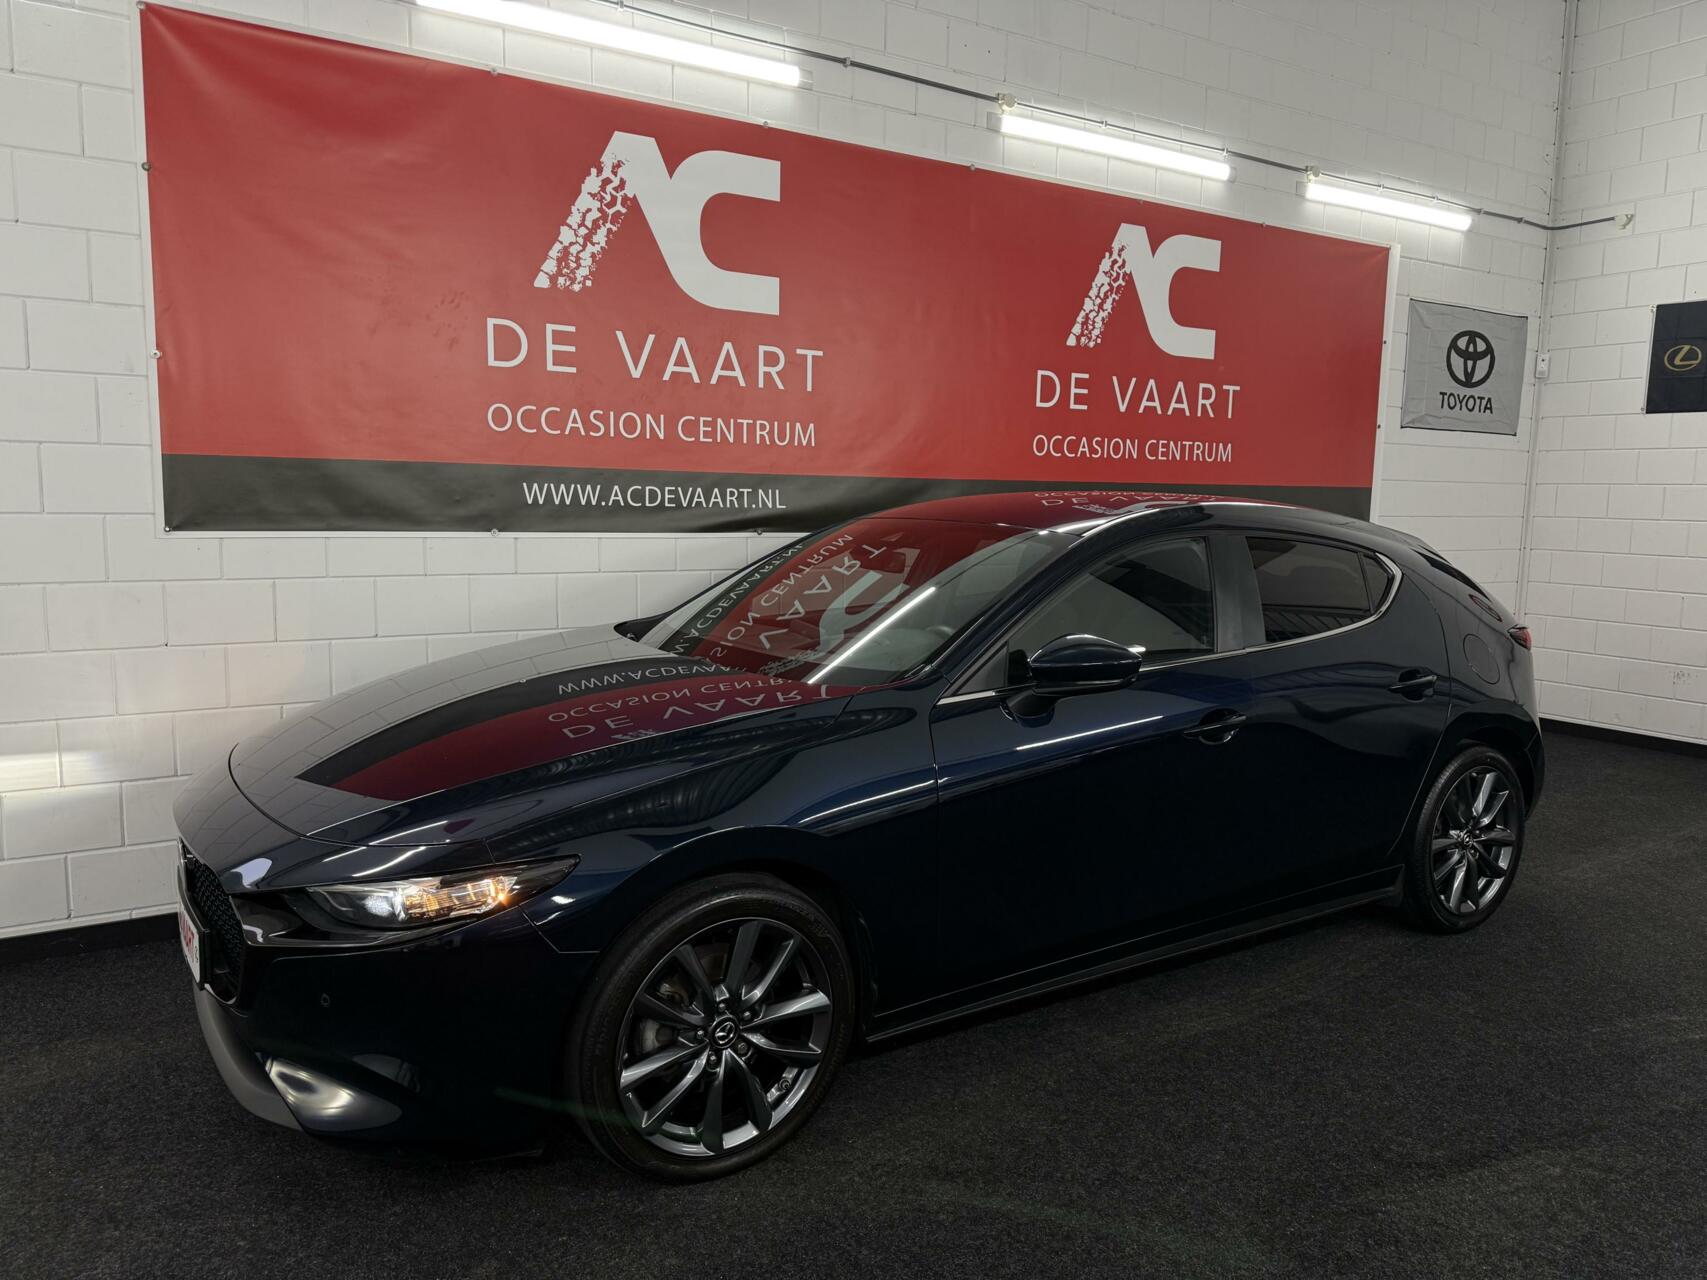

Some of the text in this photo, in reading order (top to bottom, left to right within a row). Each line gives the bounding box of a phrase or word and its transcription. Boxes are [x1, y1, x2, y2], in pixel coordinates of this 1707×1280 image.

[533, 130, 781, 316] AC
[1066, 222, 1222, 360] AC
[486, 317, 824, 392] DE VAART
[1035, 369, 1241, 419] DE VAART
[1439, 391, 1494, 414] TOYOTA
[487, 403, 816, 447] OCCASION CENTRUM
[1033, 434, 1233, 463] OCCASION CENTRUM
[522, 482, 787, 510] WWW.ACDEVAART.NL
